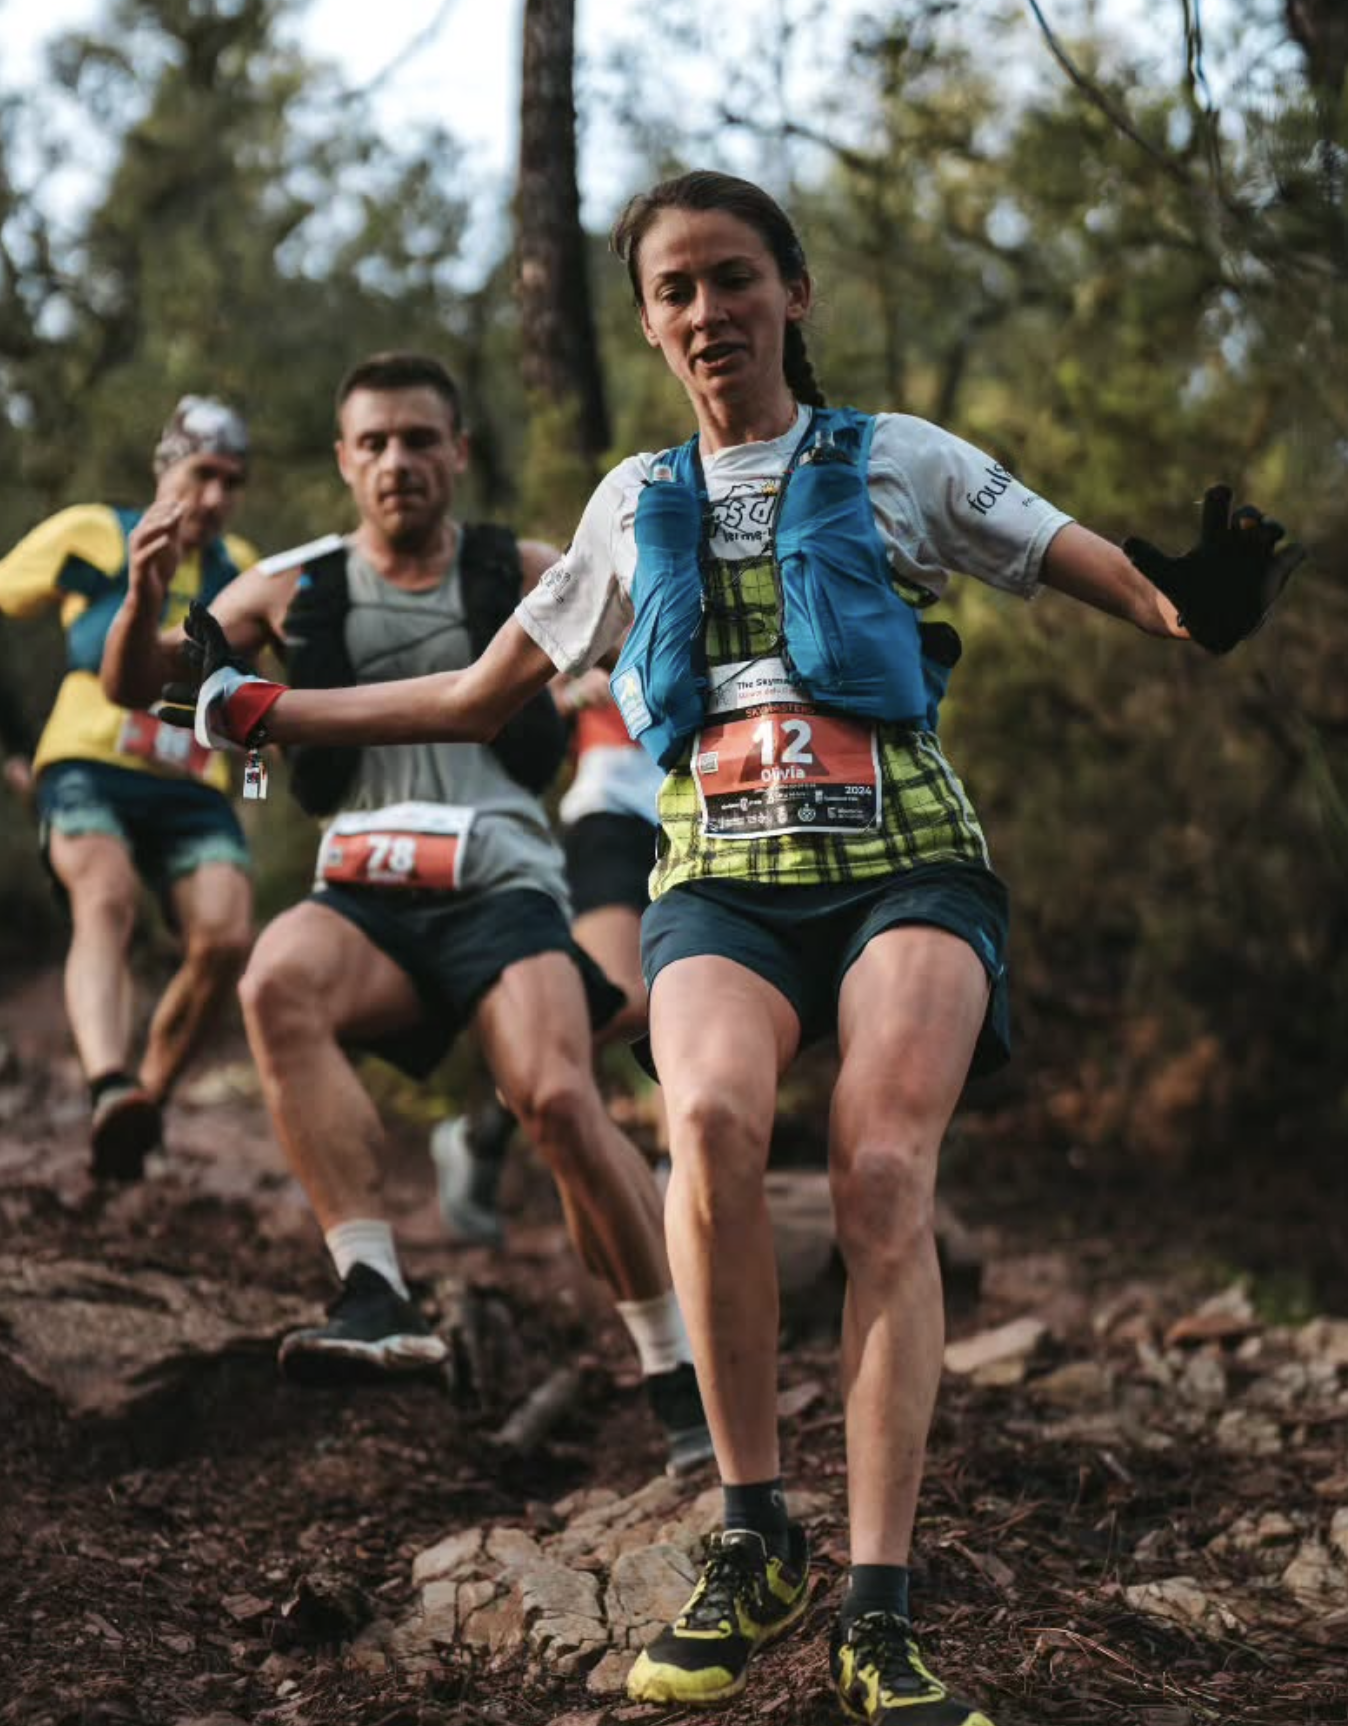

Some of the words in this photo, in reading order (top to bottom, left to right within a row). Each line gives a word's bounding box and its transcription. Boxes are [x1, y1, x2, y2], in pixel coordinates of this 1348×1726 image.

[737, 681, 754, 690] The
[752, 719, 813, 766] 12
[761, 765, 806, 782] Olivia
[844, 786, 873, 795] 2024
[367, 834, 416, 872] 78
